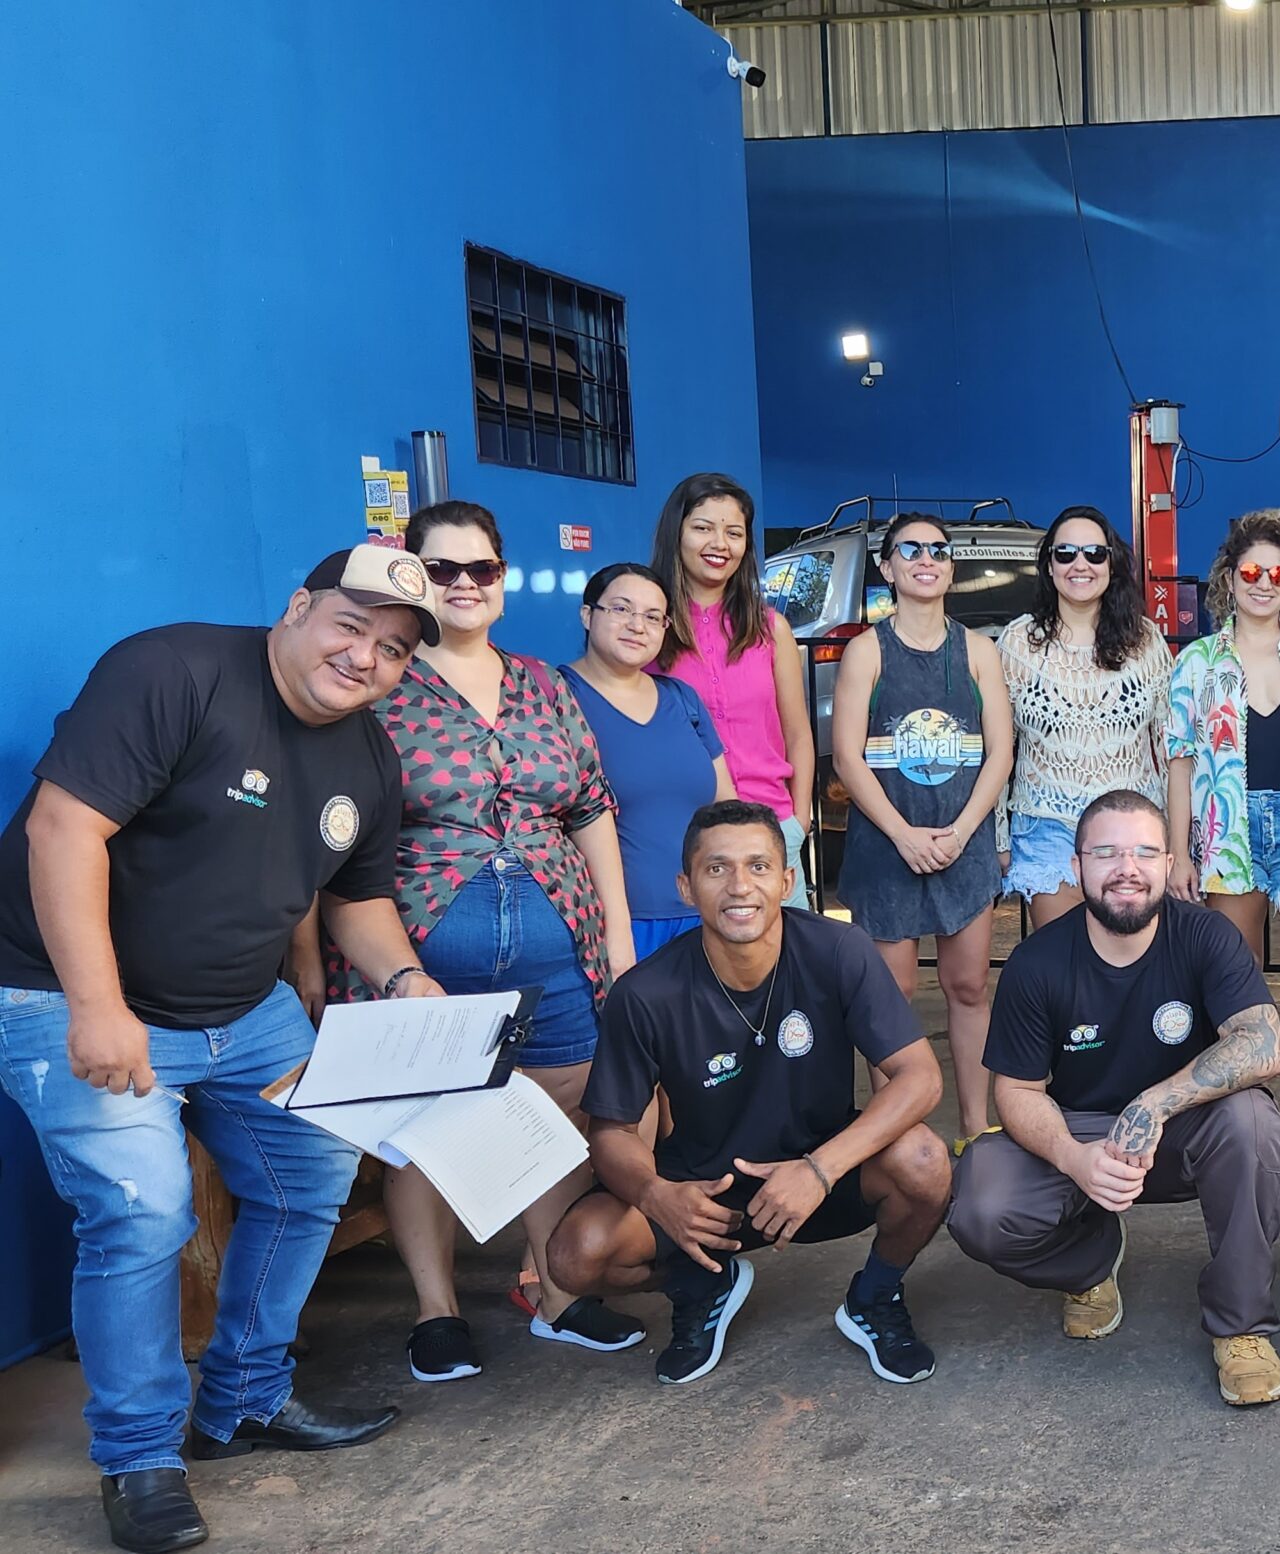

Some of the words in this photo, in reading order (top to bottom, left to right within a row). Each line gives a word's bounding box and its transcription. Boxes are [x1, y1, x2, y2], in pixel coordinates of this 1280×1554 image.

[895, 730, 961, 762] hawaii
[226, 787, 268, 808] tripadvisor
[1063, 1040, 1105, 1052] tripadvisor
[703, 1064, 744, 1088] tripadvisor
